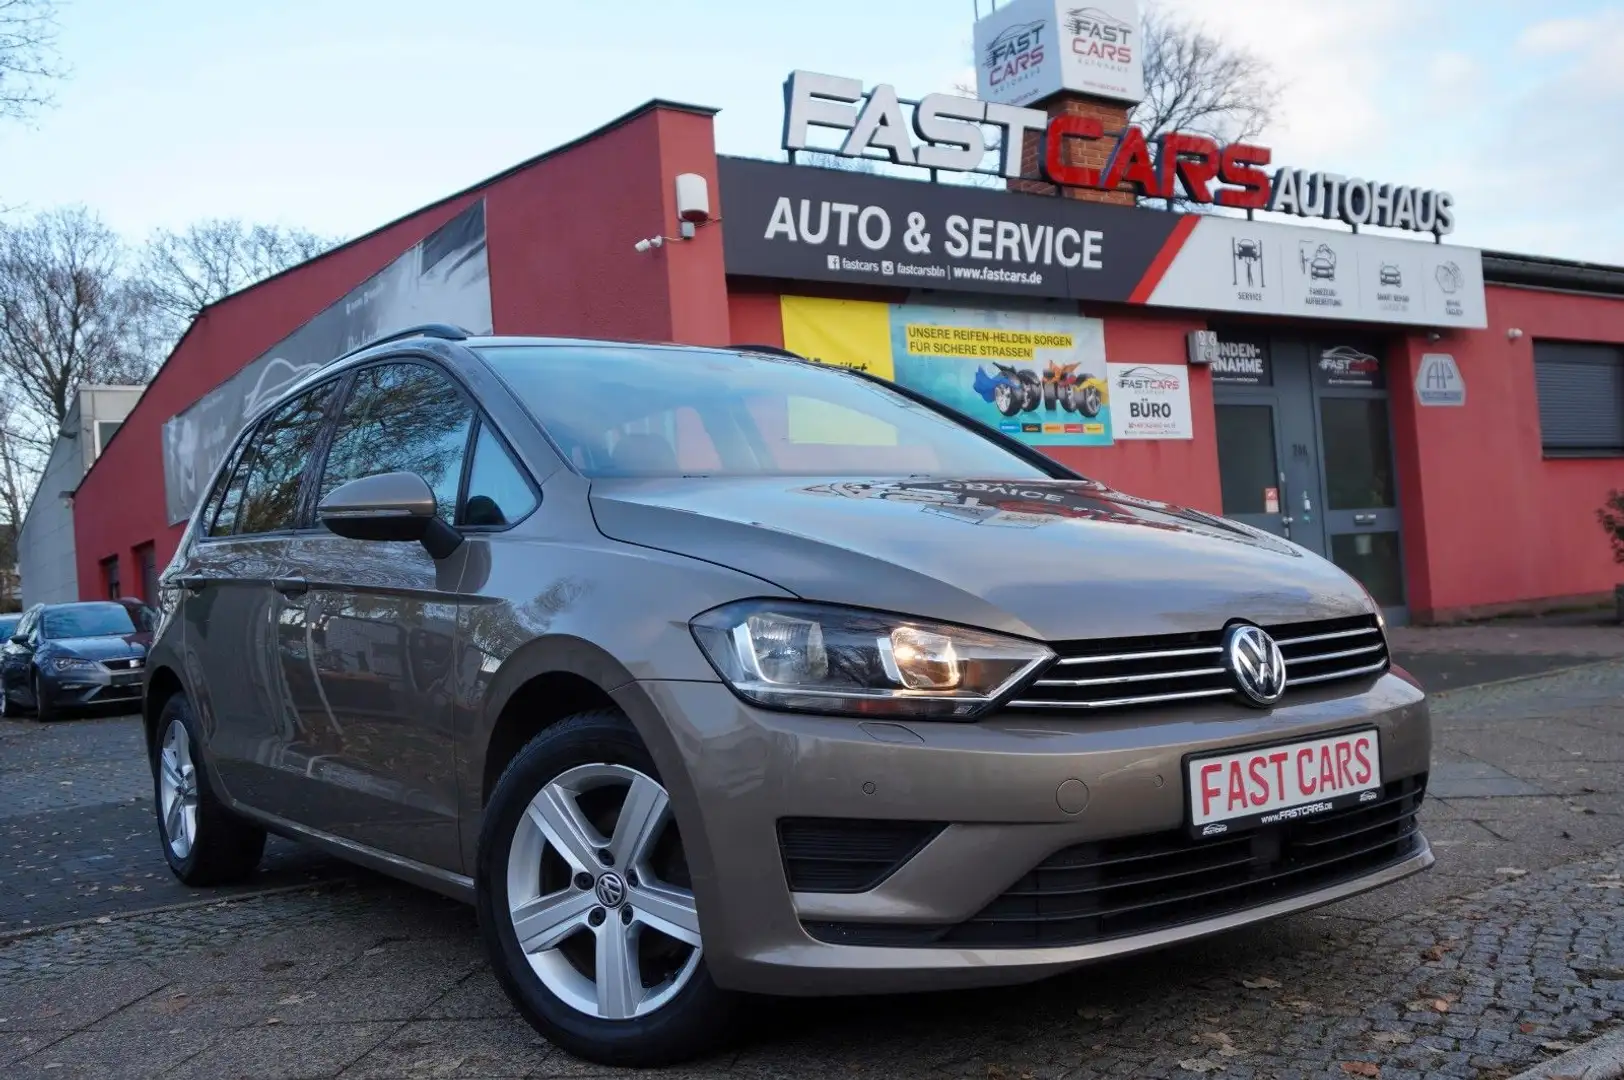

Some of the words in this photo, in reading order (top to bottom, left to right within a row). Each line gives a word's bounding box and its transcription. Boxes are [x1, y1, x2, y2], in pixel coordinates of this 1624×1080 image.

[992, 24, 1045, 66] FAST
[1075, 19, 1132, 43] FAST
[1072, 37, 1132, 65] CARS
[989, 45, 1045, 86] CARS
[1272, 166, 1455, 235] AUTOHAUS
[764, 197, 892, 250] AUTO
[903, 211, 931, 254] &
[944, 215, 1104, 268] SERVICE
[842, 258, 880, 272] fastcars
[953, 266, 1043, 284] www.fastcars.de
[908, 327, 951, 340] UNSERE
[953, 330, 1032, 344] REIFEN-HELDEN
[1034, 334, 1073, 347] SORGEN
[909, 339, 931, 353] FÜR
[933, 343, 978, 356] SICHERE
[980, 345, 1033, 358] STRASSEN!
[1130, 398, 1172, 418] BÜRO
[1200, 752, 1288, 816] FAST
[1296, 738, 1372, 796] CARS
